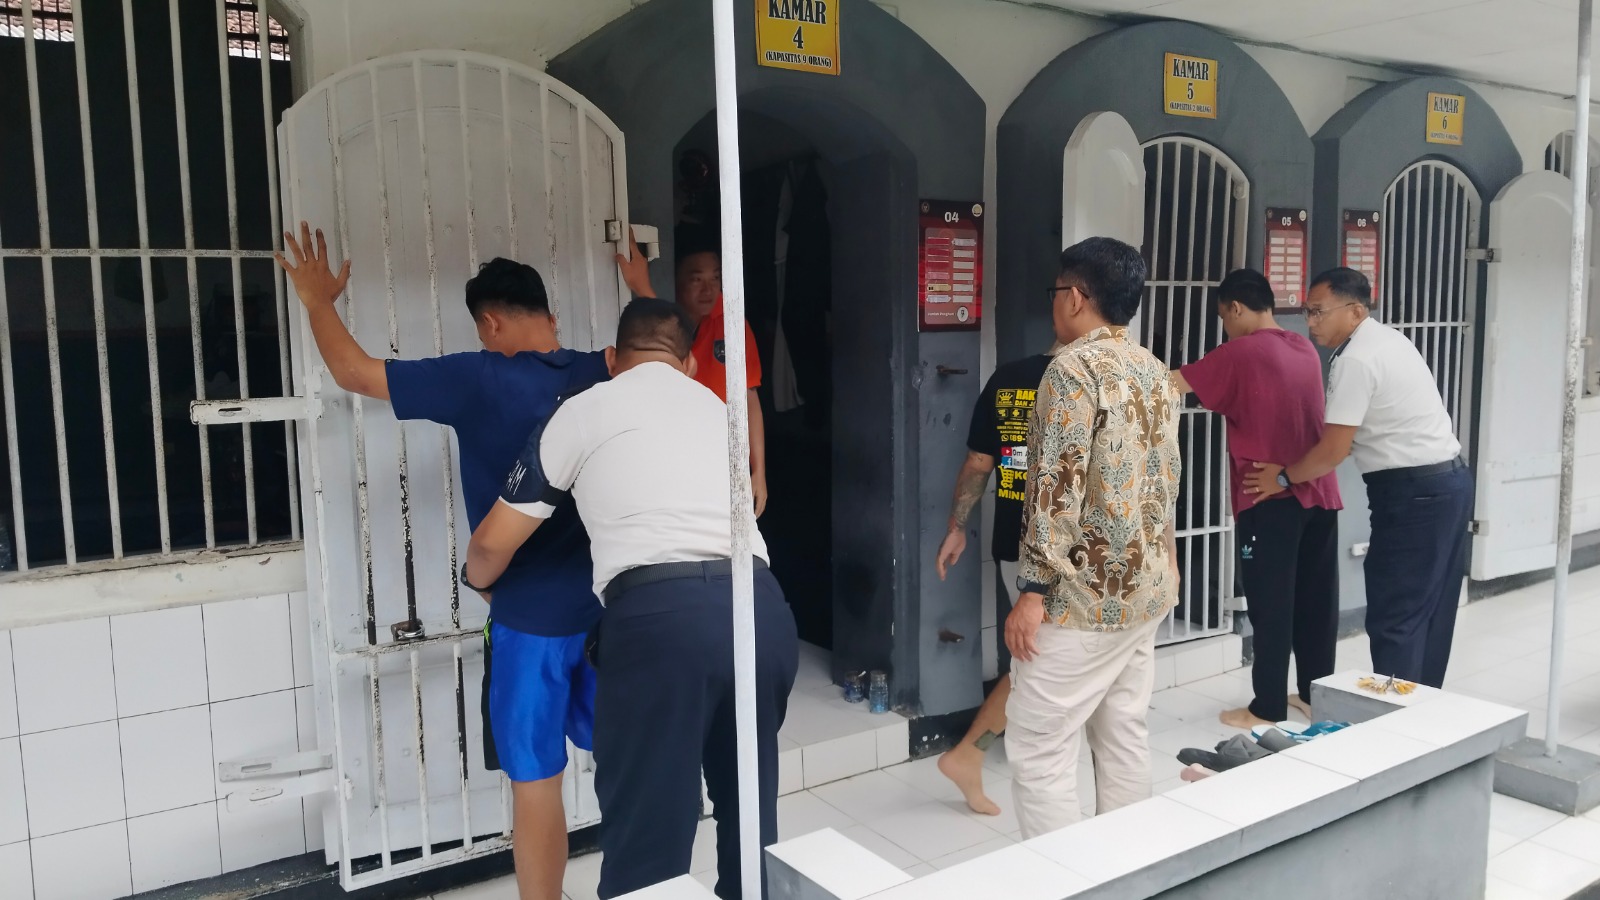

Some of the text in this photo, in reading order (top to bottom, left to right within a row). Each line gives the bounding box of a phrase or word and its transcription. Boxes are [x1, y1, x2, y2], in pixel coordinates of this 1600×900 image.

[768, 0, 827, 24] KAMAR
[792, 26, 804, 49] 4
[766, 51, 832, 68] (KAPASITAS 9 ORANG)
[1173, 59, 1209, 80] KAMAR
[1187, 83, 1194, 99] 5
[1434, 96, 1459, 113] KAMAR
[1442, 116, 1448, 129] 6
[944, 211, 959, 223] 04
[1281, 217, 1292, 226] 05
[1357, 218, 1367, 227] 06
